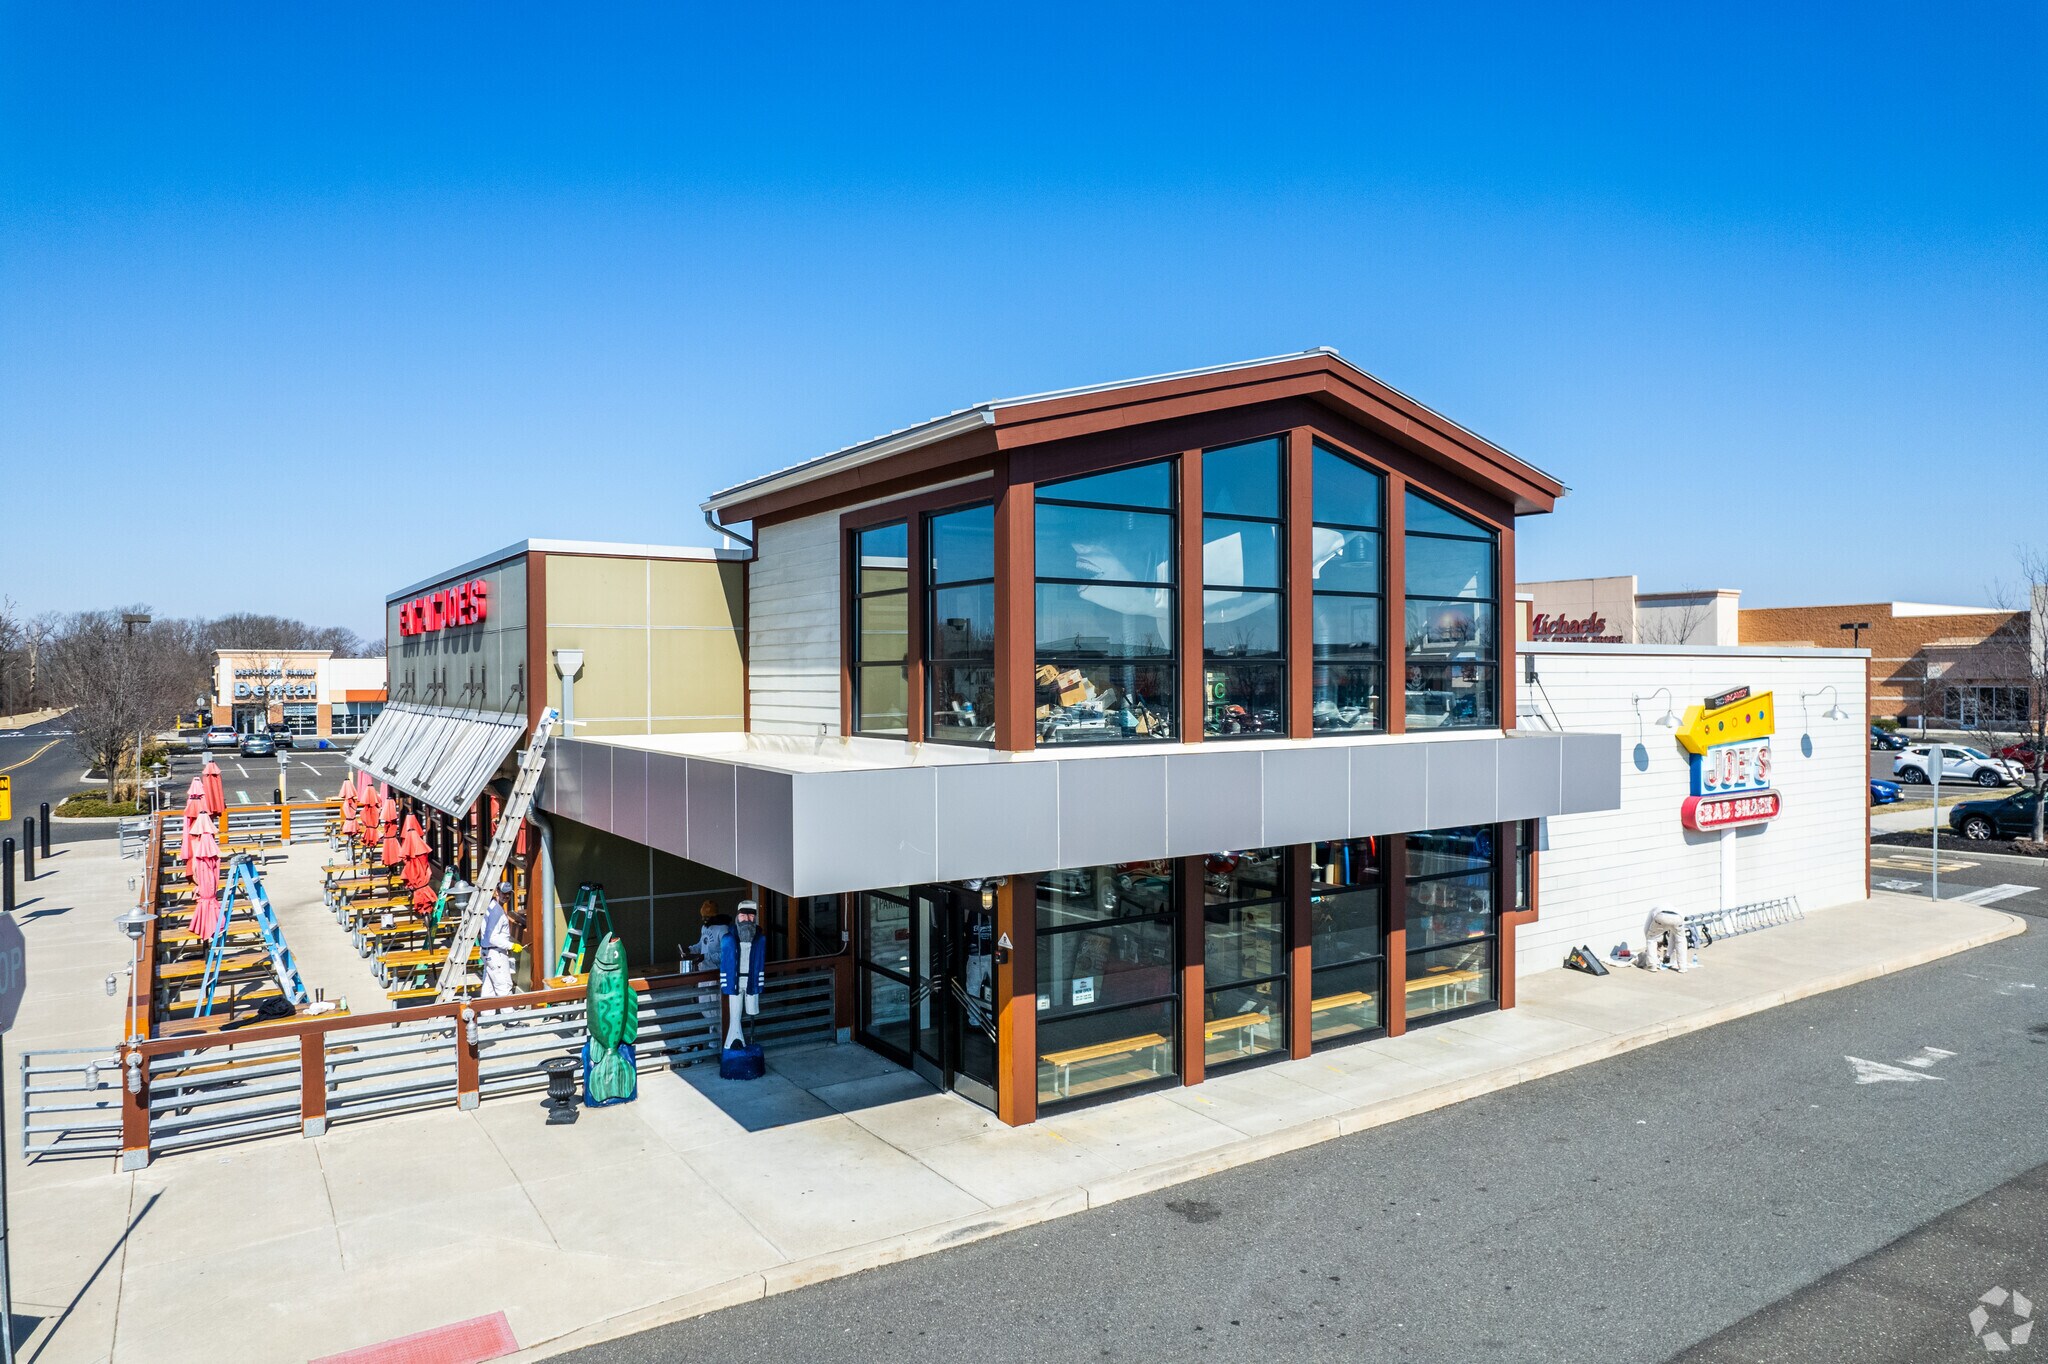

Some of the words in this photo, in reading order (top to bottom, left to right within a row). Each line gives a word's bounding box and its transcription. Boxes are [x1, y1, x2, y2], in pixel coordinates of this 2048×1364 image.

[234, 669, 283, 679] DEPTFORD
[285, 669, 316, 679] FAMILY
[234, 681, 317, 699] Dental
[1705, 746, 1772, 787] JOE'S
[1698, 801, 1731, 822] CRAB
[1734, 796, 1776, 818] SHACK
